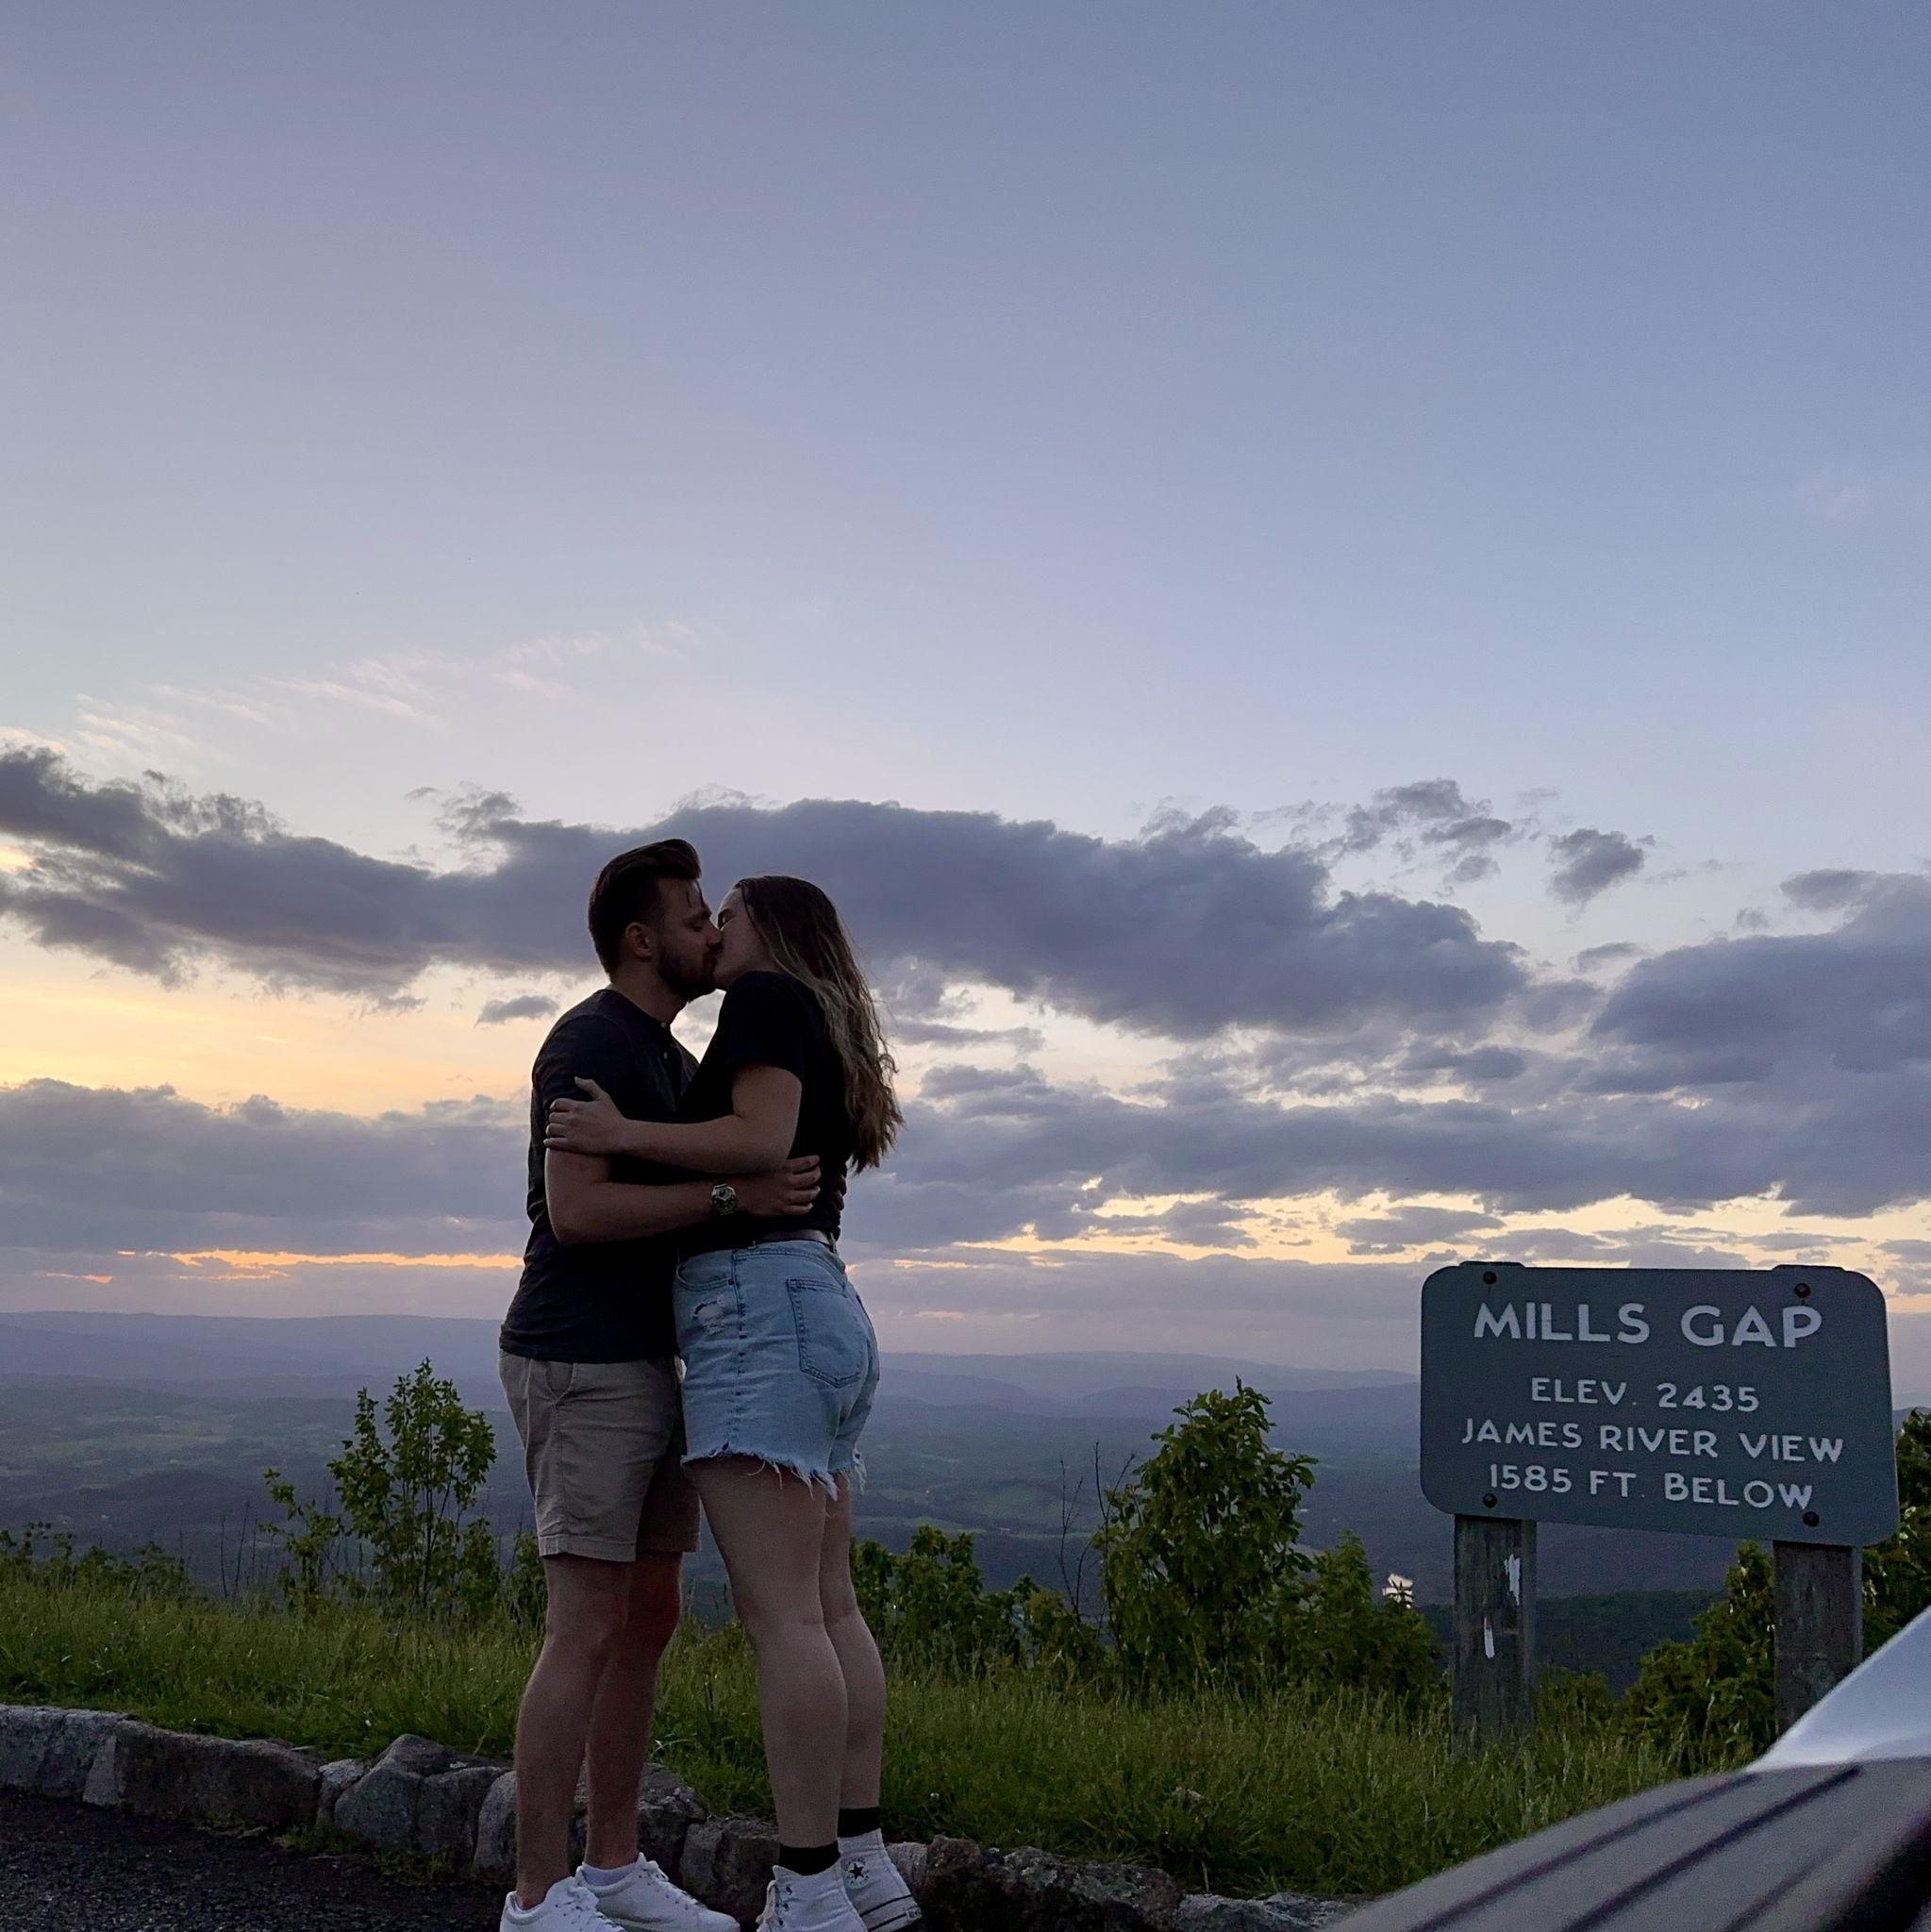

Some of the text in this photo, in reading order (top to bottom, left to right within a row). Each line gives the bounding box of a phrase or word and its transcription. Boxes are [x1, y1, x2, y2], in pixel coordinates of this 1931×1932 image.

[1473, 1303, 1823, 1347] MILLS GAP
[1656, 1382, 1759, 1412] 2435
[1461, 1418, 1844, 1463] JAMES RIVER VIEW
[1490, 1463, 1573, 1493] 1585
[1664, 1472, 1813, 1510] BELOW
